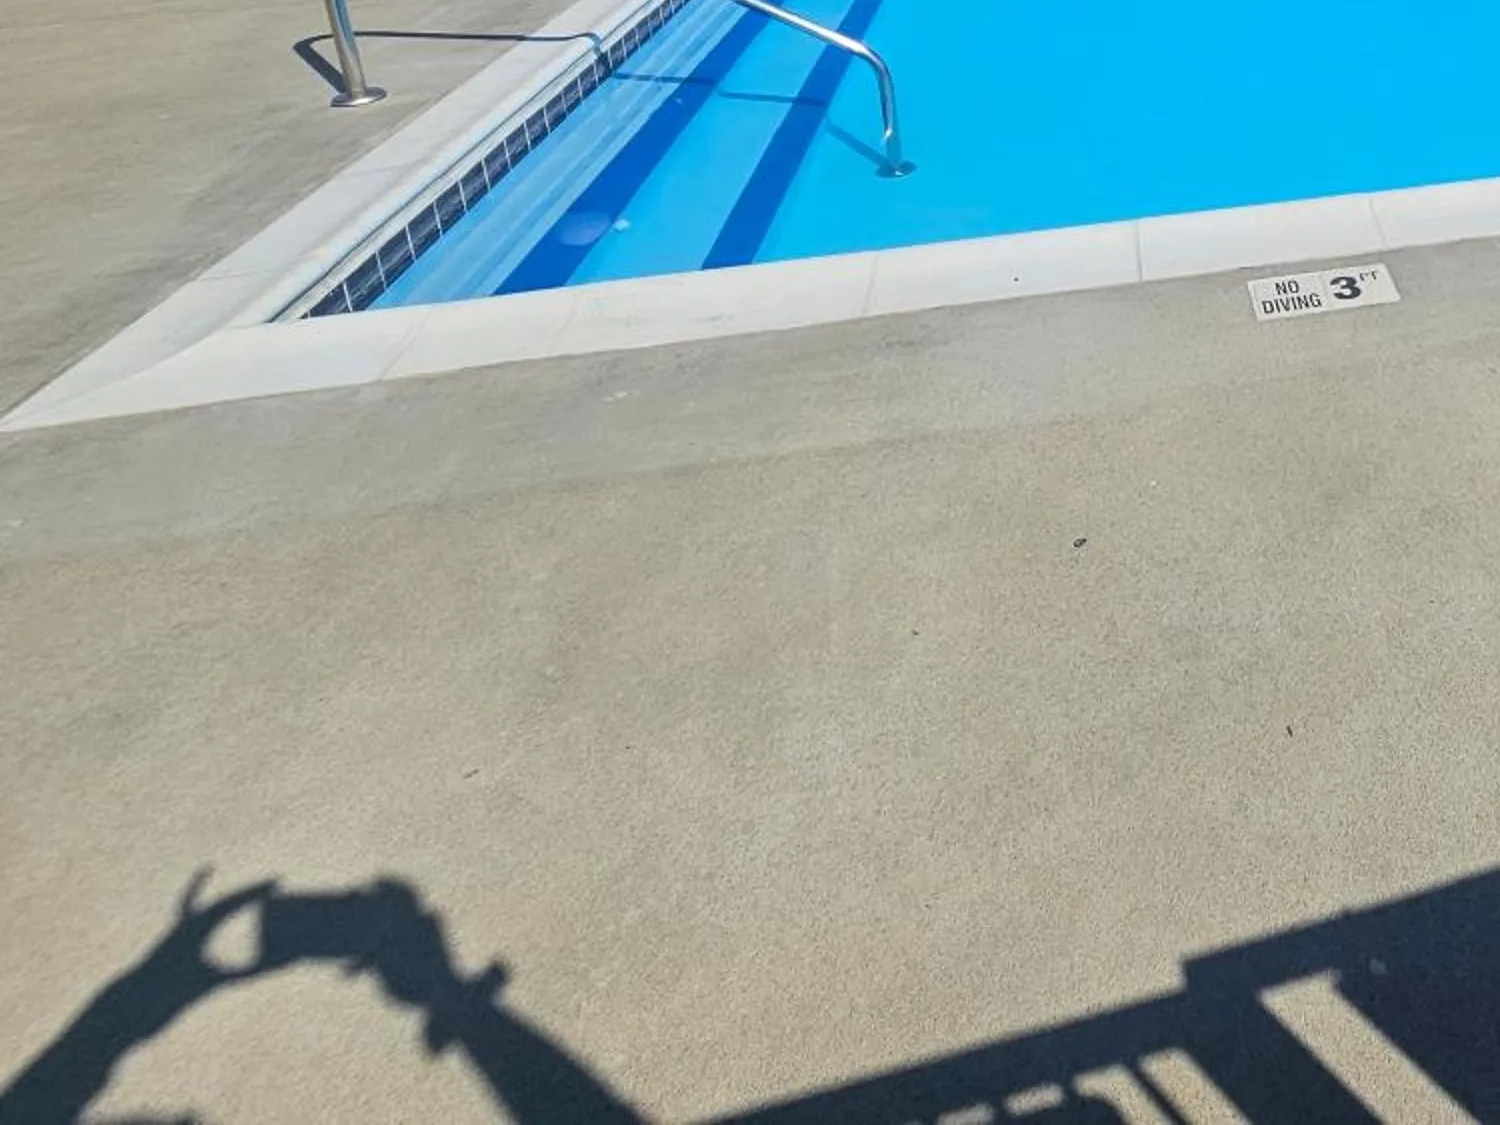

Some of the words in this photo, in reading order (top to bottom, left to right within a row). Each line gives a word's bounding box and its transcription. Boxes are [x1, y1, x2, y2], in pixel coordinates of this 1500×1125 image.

[1275, 280, 1300, 296] NO
[1329, 275, 1362, 300] 3
[1261, 292, 1322, 314] DIVING
